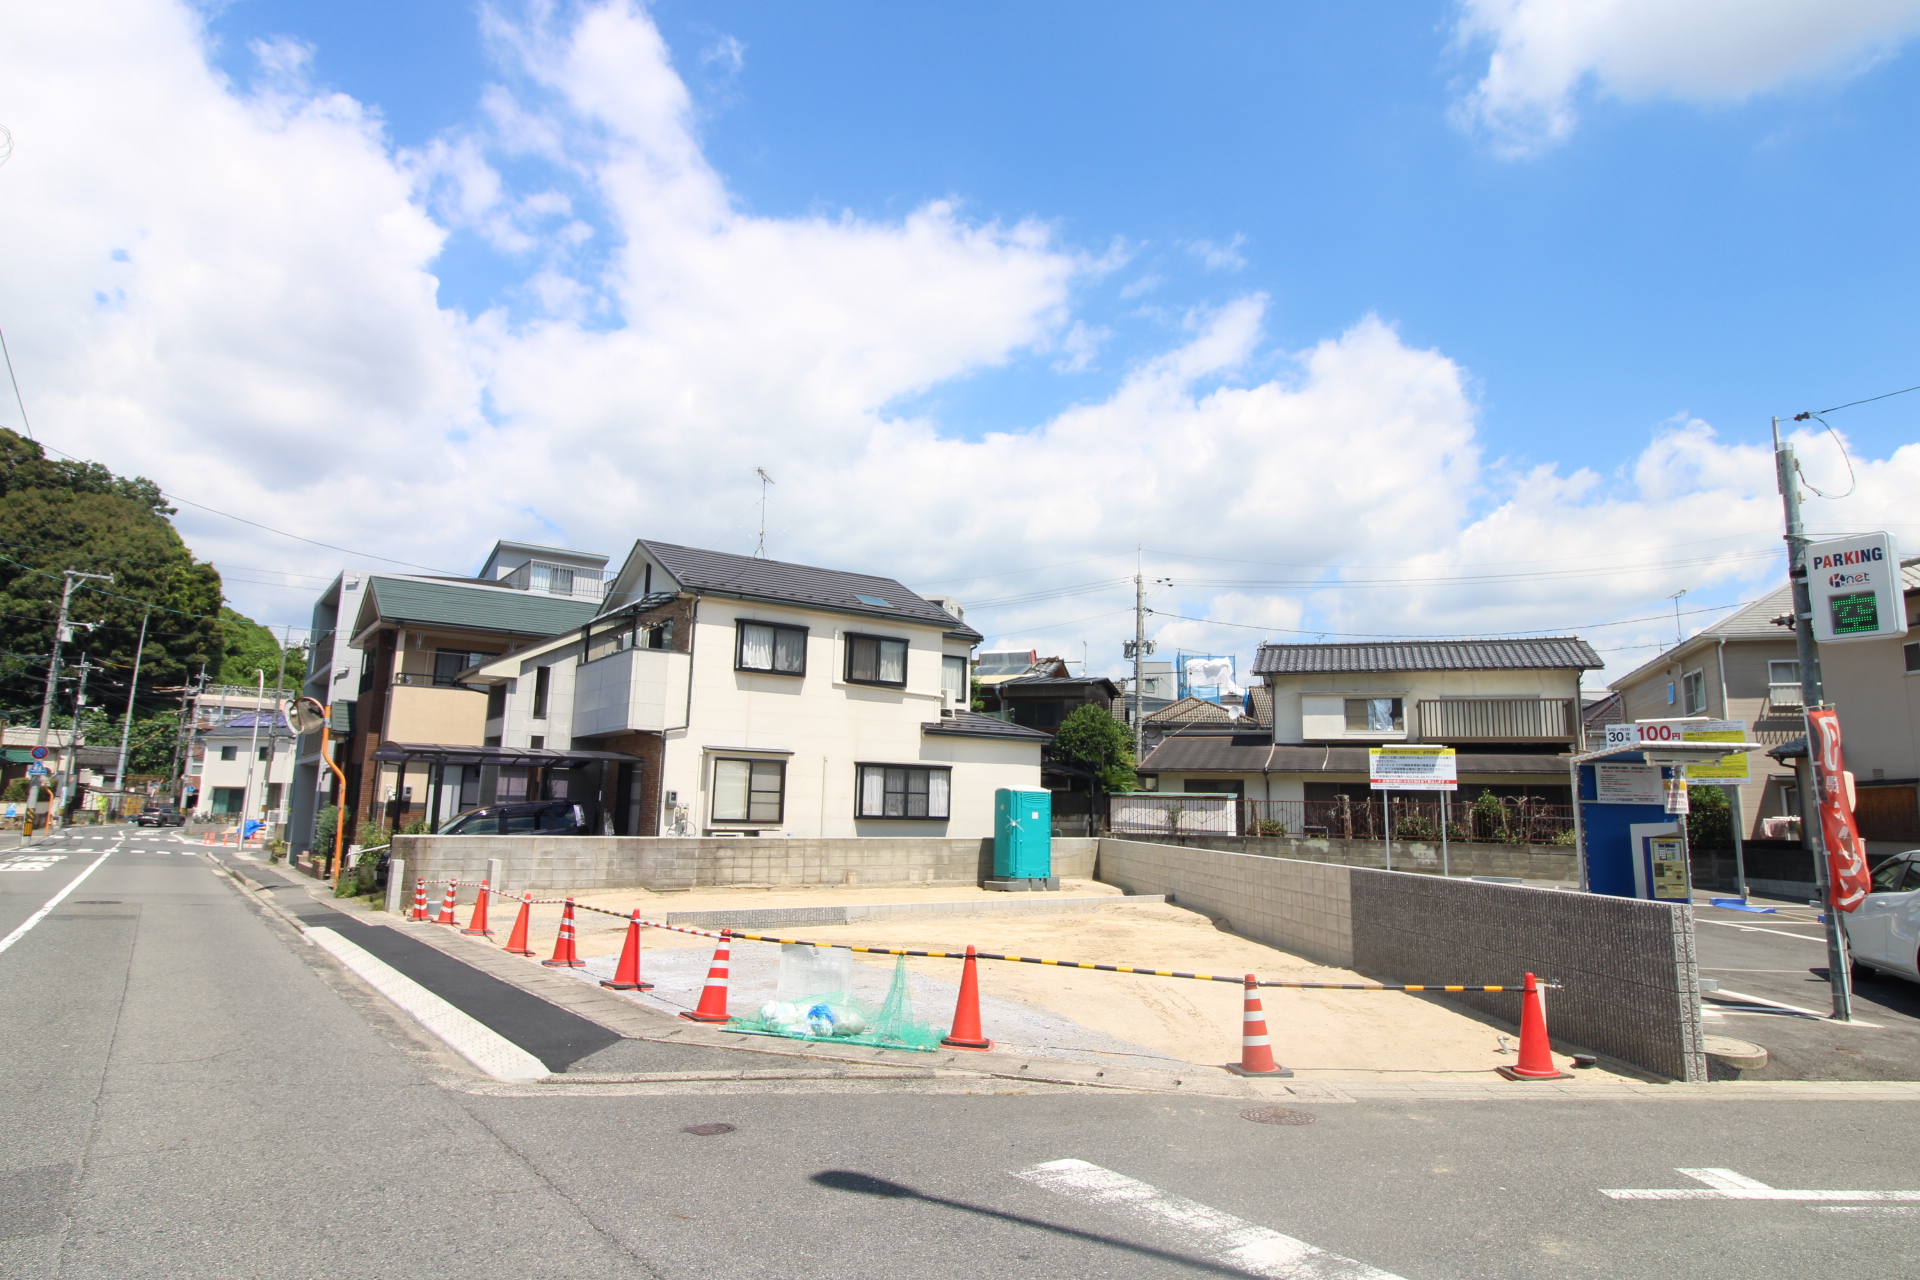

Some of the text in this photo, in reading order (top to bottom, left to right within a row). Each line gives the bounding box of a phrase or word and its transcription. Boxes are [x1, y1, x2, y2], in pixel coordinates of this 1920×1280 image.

[1813, 547, 1883, 570] PARKING
[1832, 594, 1879, 634] 空
[1608, 731, 1624, 742] 30
